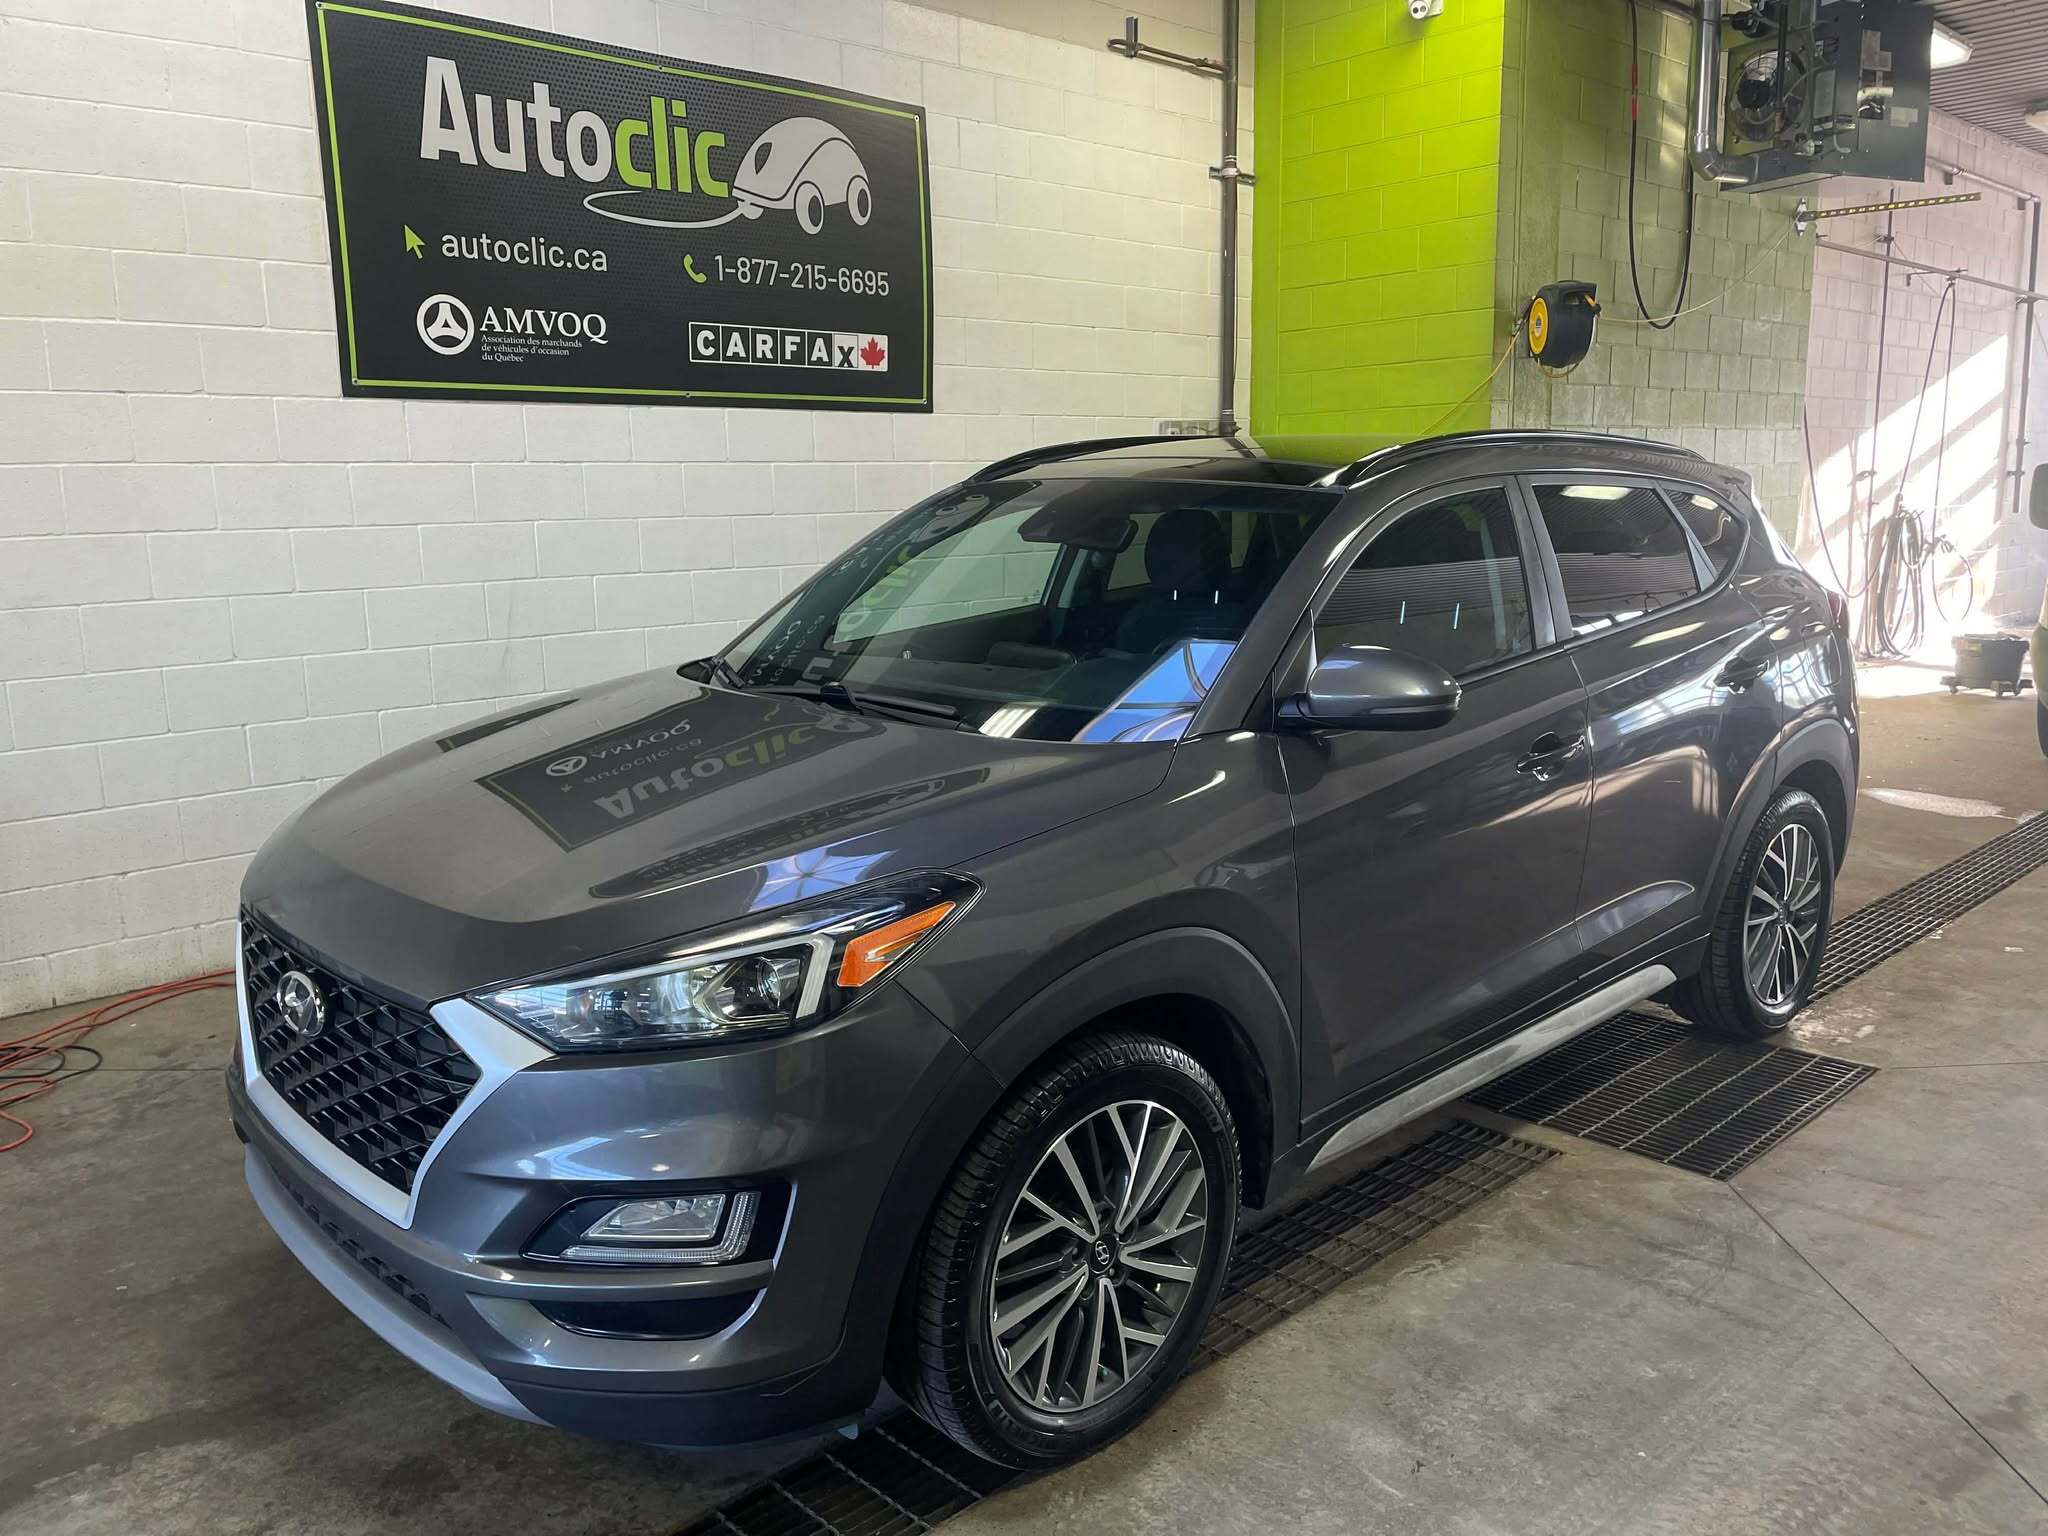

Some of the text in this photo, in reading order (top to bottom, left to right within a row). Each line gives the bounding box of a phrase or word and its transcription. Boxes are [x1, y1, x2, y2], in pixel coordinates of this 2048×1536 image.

[420, 55, 729, 198] Autoclic
[441, 233, 609, 272] autoclic.ca
[714, 254, 890, 296] 1-877-215-6695
[480, 305, 609, 344] AMVOQ
[481, 334, 583, 348] Association des marchands
[481, 343, 570, 356] de véhicules d'occasion
[482, 352, 524, 363] du Québec
[696, 329, 855, 368] CARFAX
